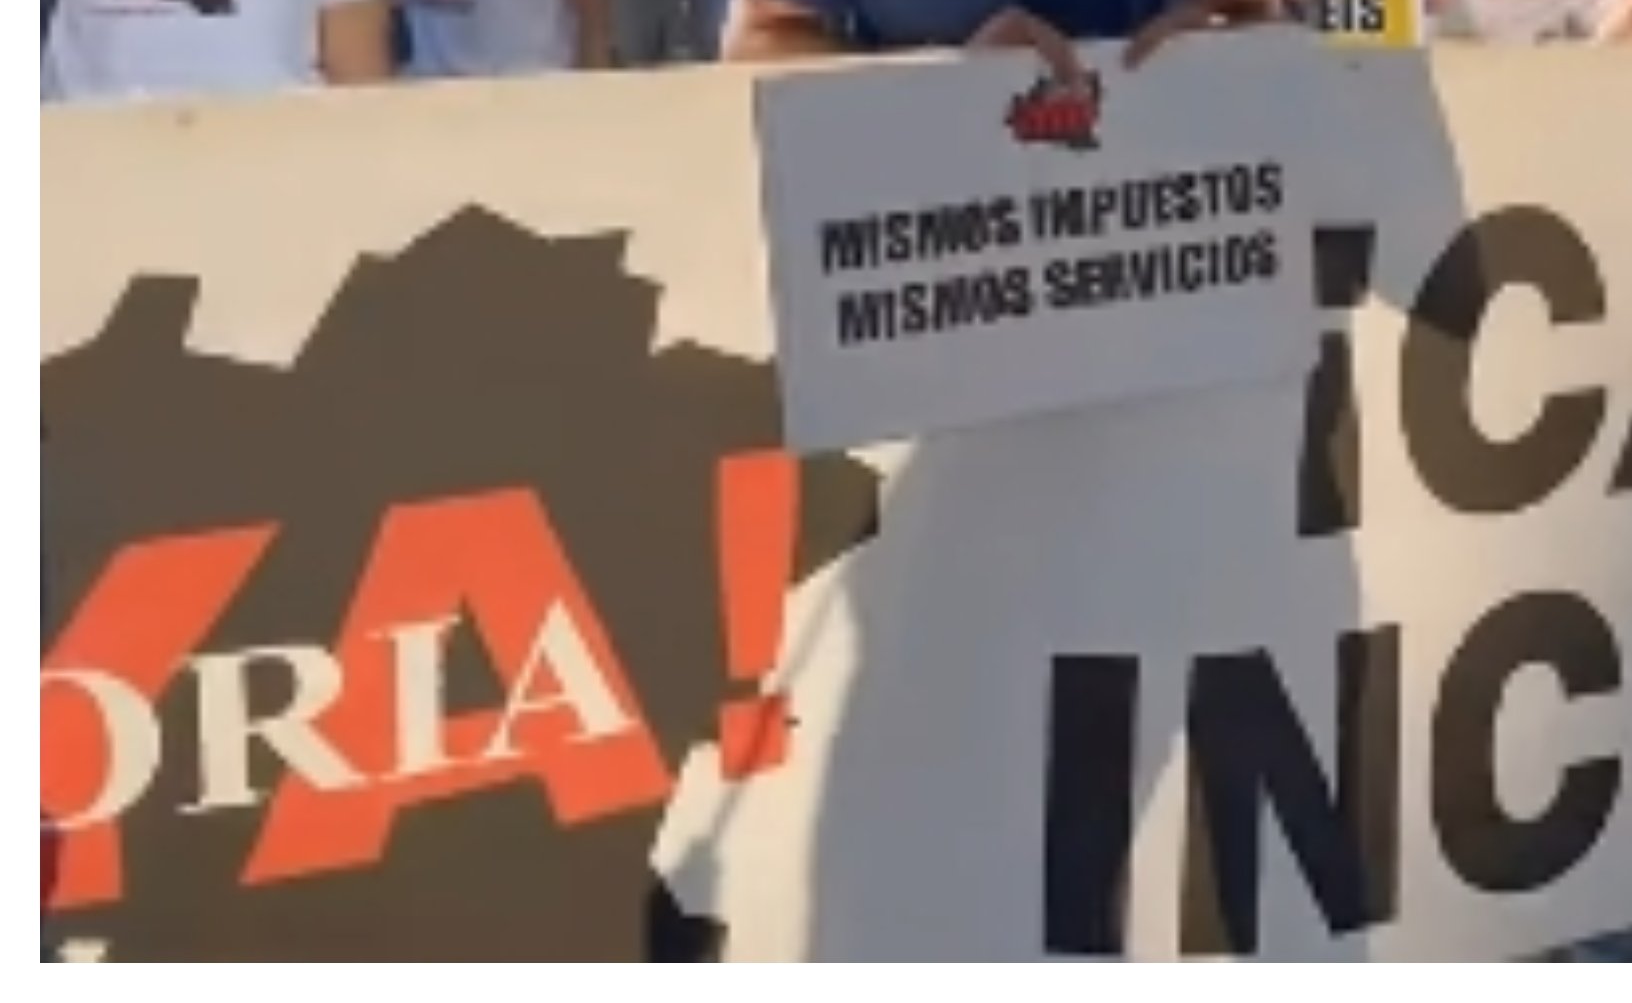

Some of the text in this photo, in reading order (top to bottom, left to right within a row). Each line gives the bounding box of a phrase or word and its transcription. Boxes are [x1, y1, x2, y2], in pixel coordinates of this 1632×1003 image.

[820, 162, 1285, 275] MISMOS IMPUESTOS
[837, 229, 1279, 345] MISMOS SERVICIOS
